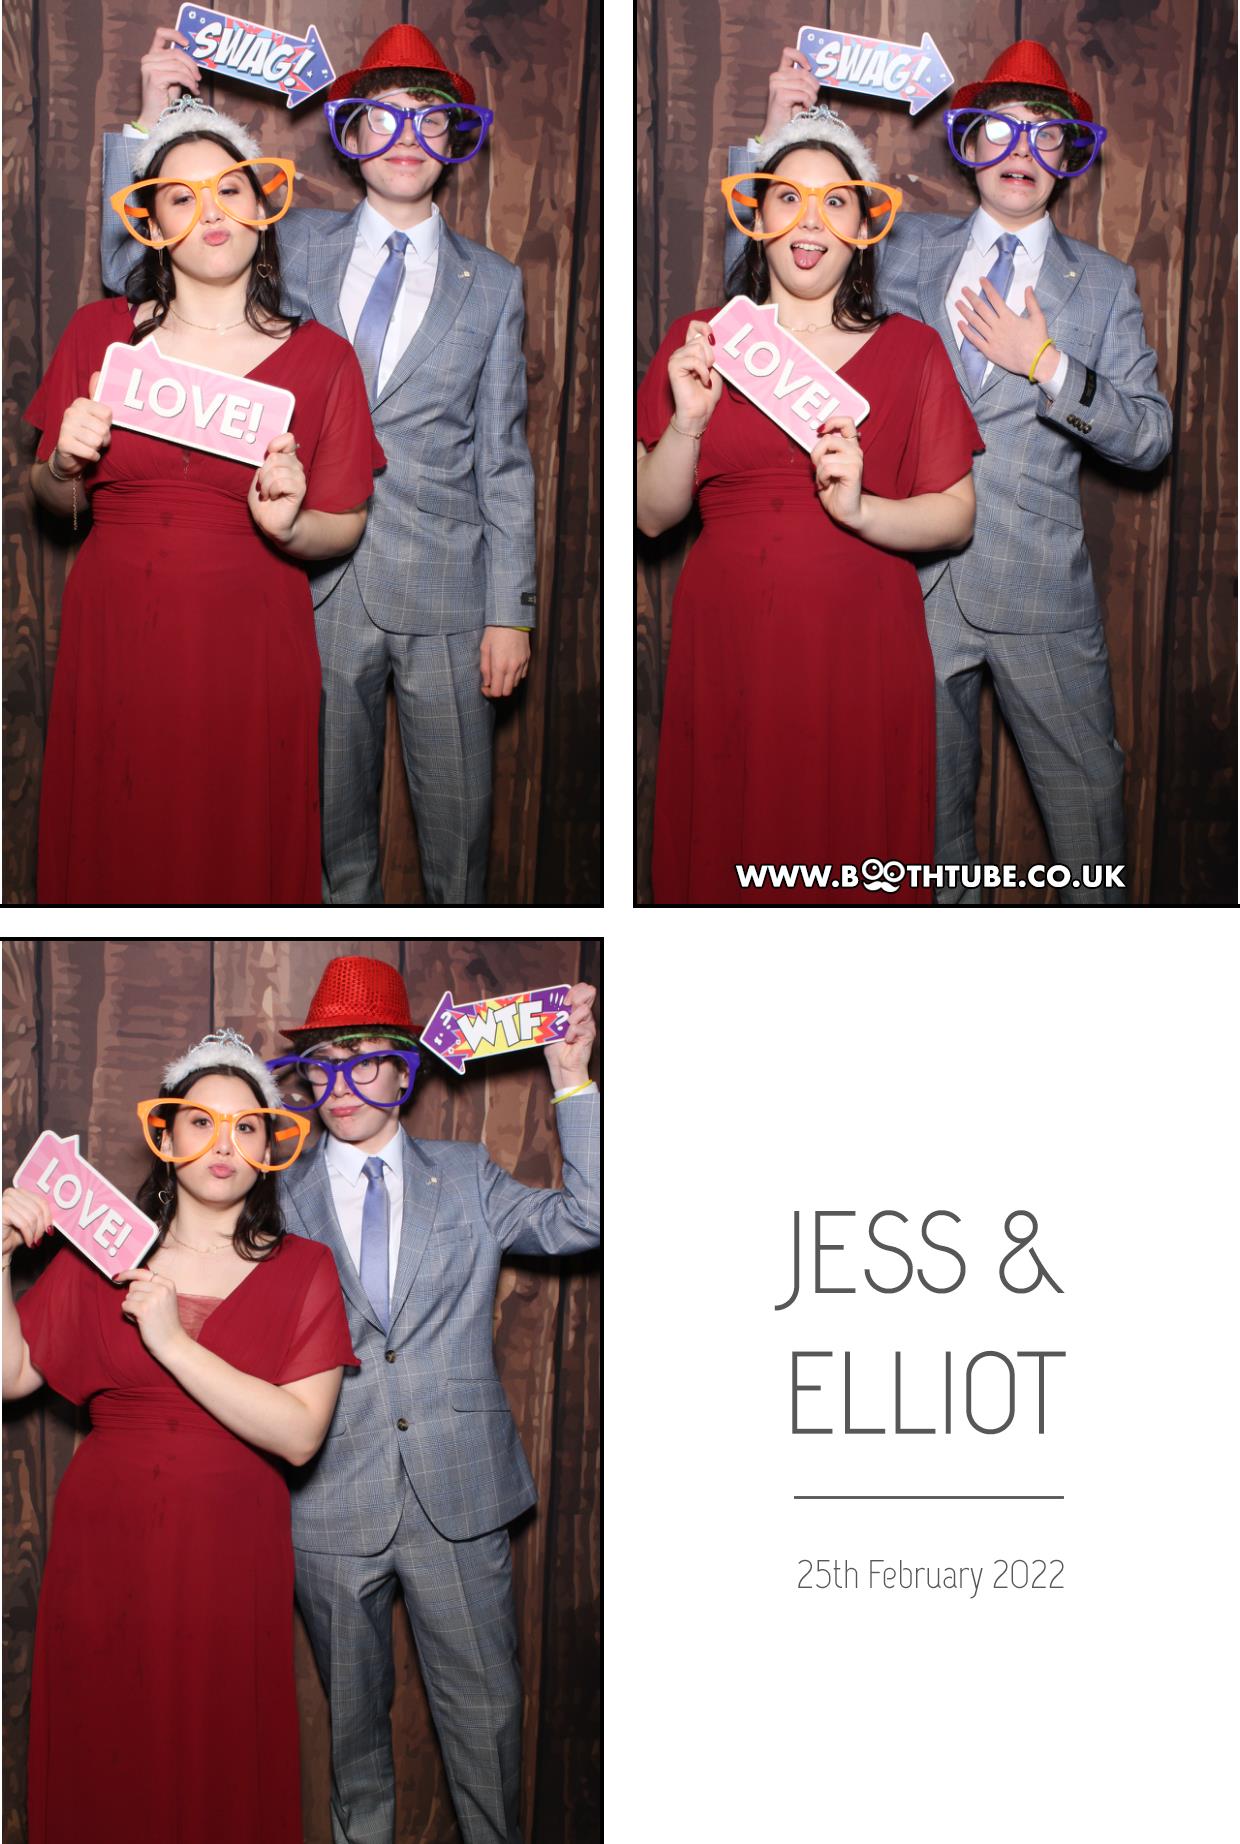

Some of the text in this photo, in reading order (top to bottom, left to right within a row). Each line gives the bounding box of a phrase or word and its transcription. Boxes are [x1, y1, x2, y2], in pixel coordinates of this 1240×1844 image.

[192, 22, 316, 87] SWAG!
[815, 40, 932, 95] SWAG!
[122, 367, 265, 445] LOVE!
[722, 322, 841, 431] LOVE!
[36, 1156, 134, 1258] LOVE!
